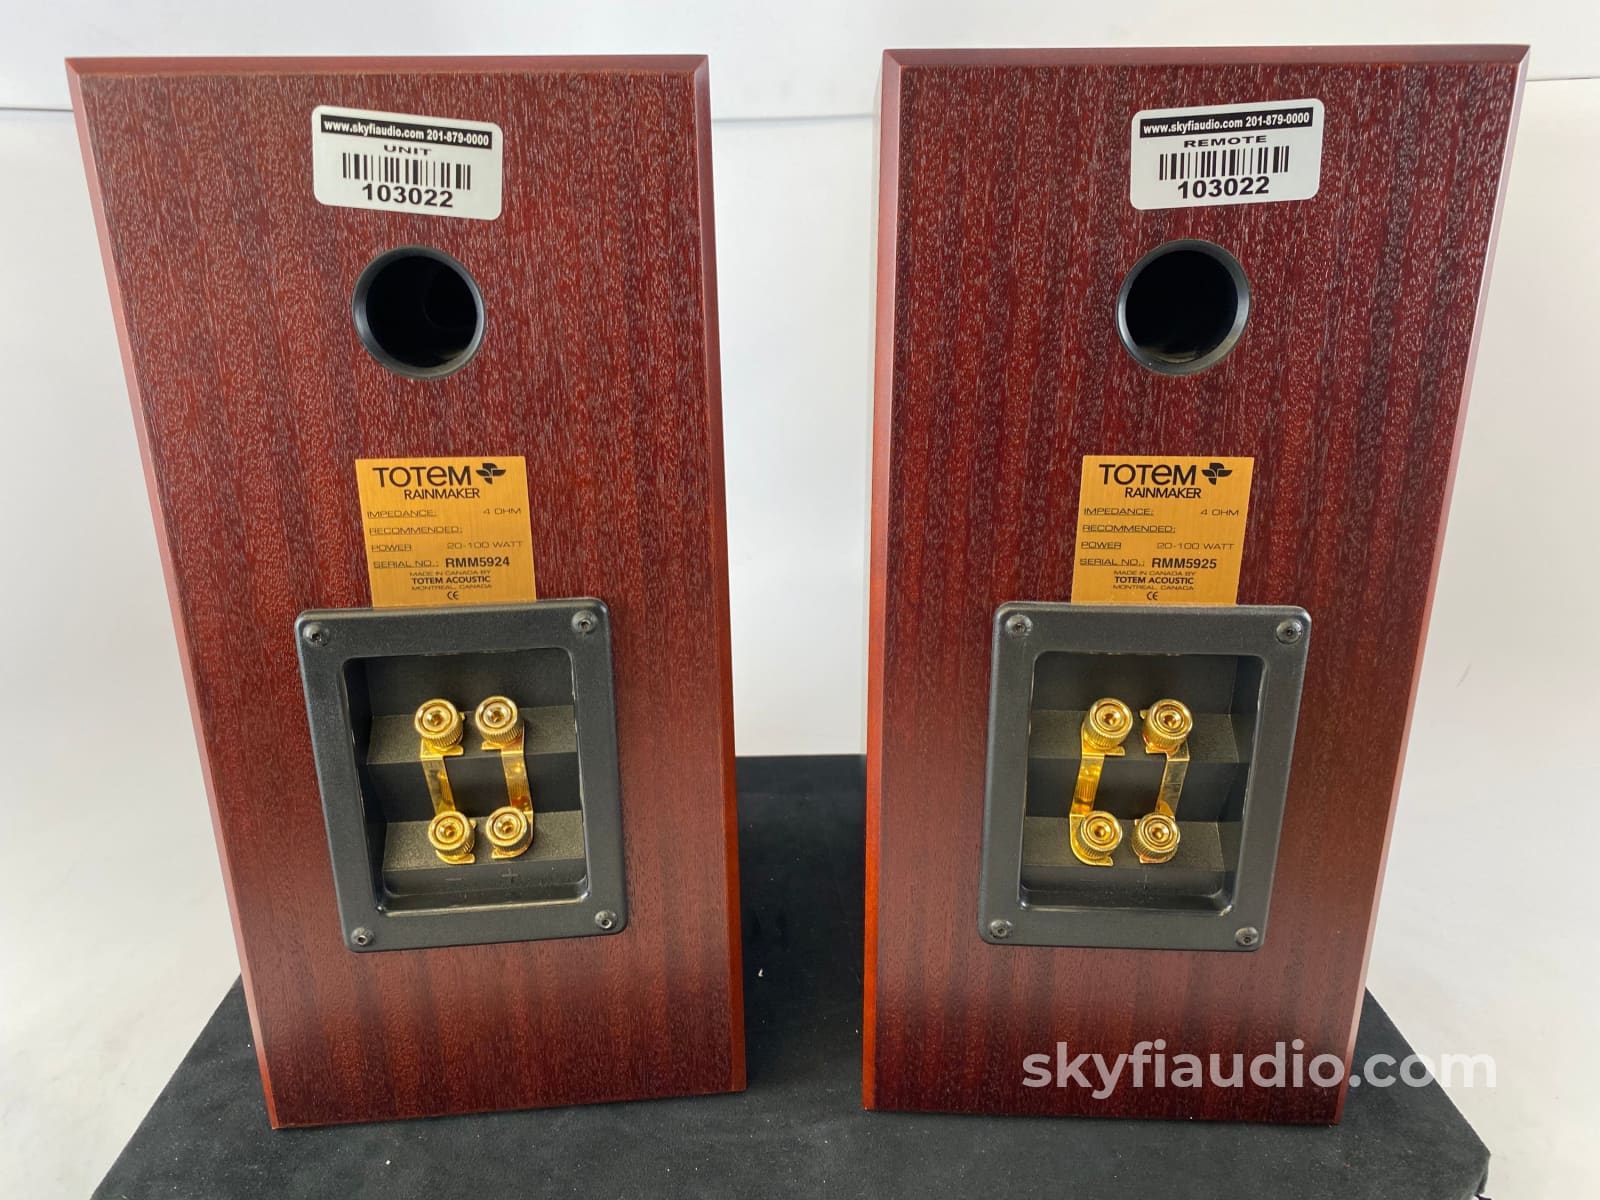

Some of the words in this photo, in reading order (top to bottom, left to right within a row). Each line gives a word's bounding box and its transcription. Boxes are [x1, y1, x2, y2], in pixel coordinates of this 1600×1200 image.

[1143, 118, 1243, 134] www.skyfiaudio.com
[1245, 112, 1310, 127] 201-879-0000
[324, 120, 424, 139] www.skyfiaudio.com
[427, 129, 489, 146] 201-879-0000
[1184, 135, 1267, 148] REMOTE
[384, 145, 432, 156] UNIT
[1178, 176, 1270, 199] 103022
[362, 183, 453, 208] 103022
[404, 488, 480, 500] RAINMAKER
[1125, 487, 1202, 498] RAINMAKER
[367, 510, 437, 519] IMPEDANCE:
[1084, 508, 1154, 516] IMPEDANCE:
[369, 526, 462, 535] RECOMMENDED:
[1082, 525, 1176, 533] RECOMMENDED:
[371, 544, 412, 552] POWER
[1081, 542, 1121, 550] POWER
[445, 557, 510, 568] RMM5924
[1152, 558, 1217, 568] RMM5925
